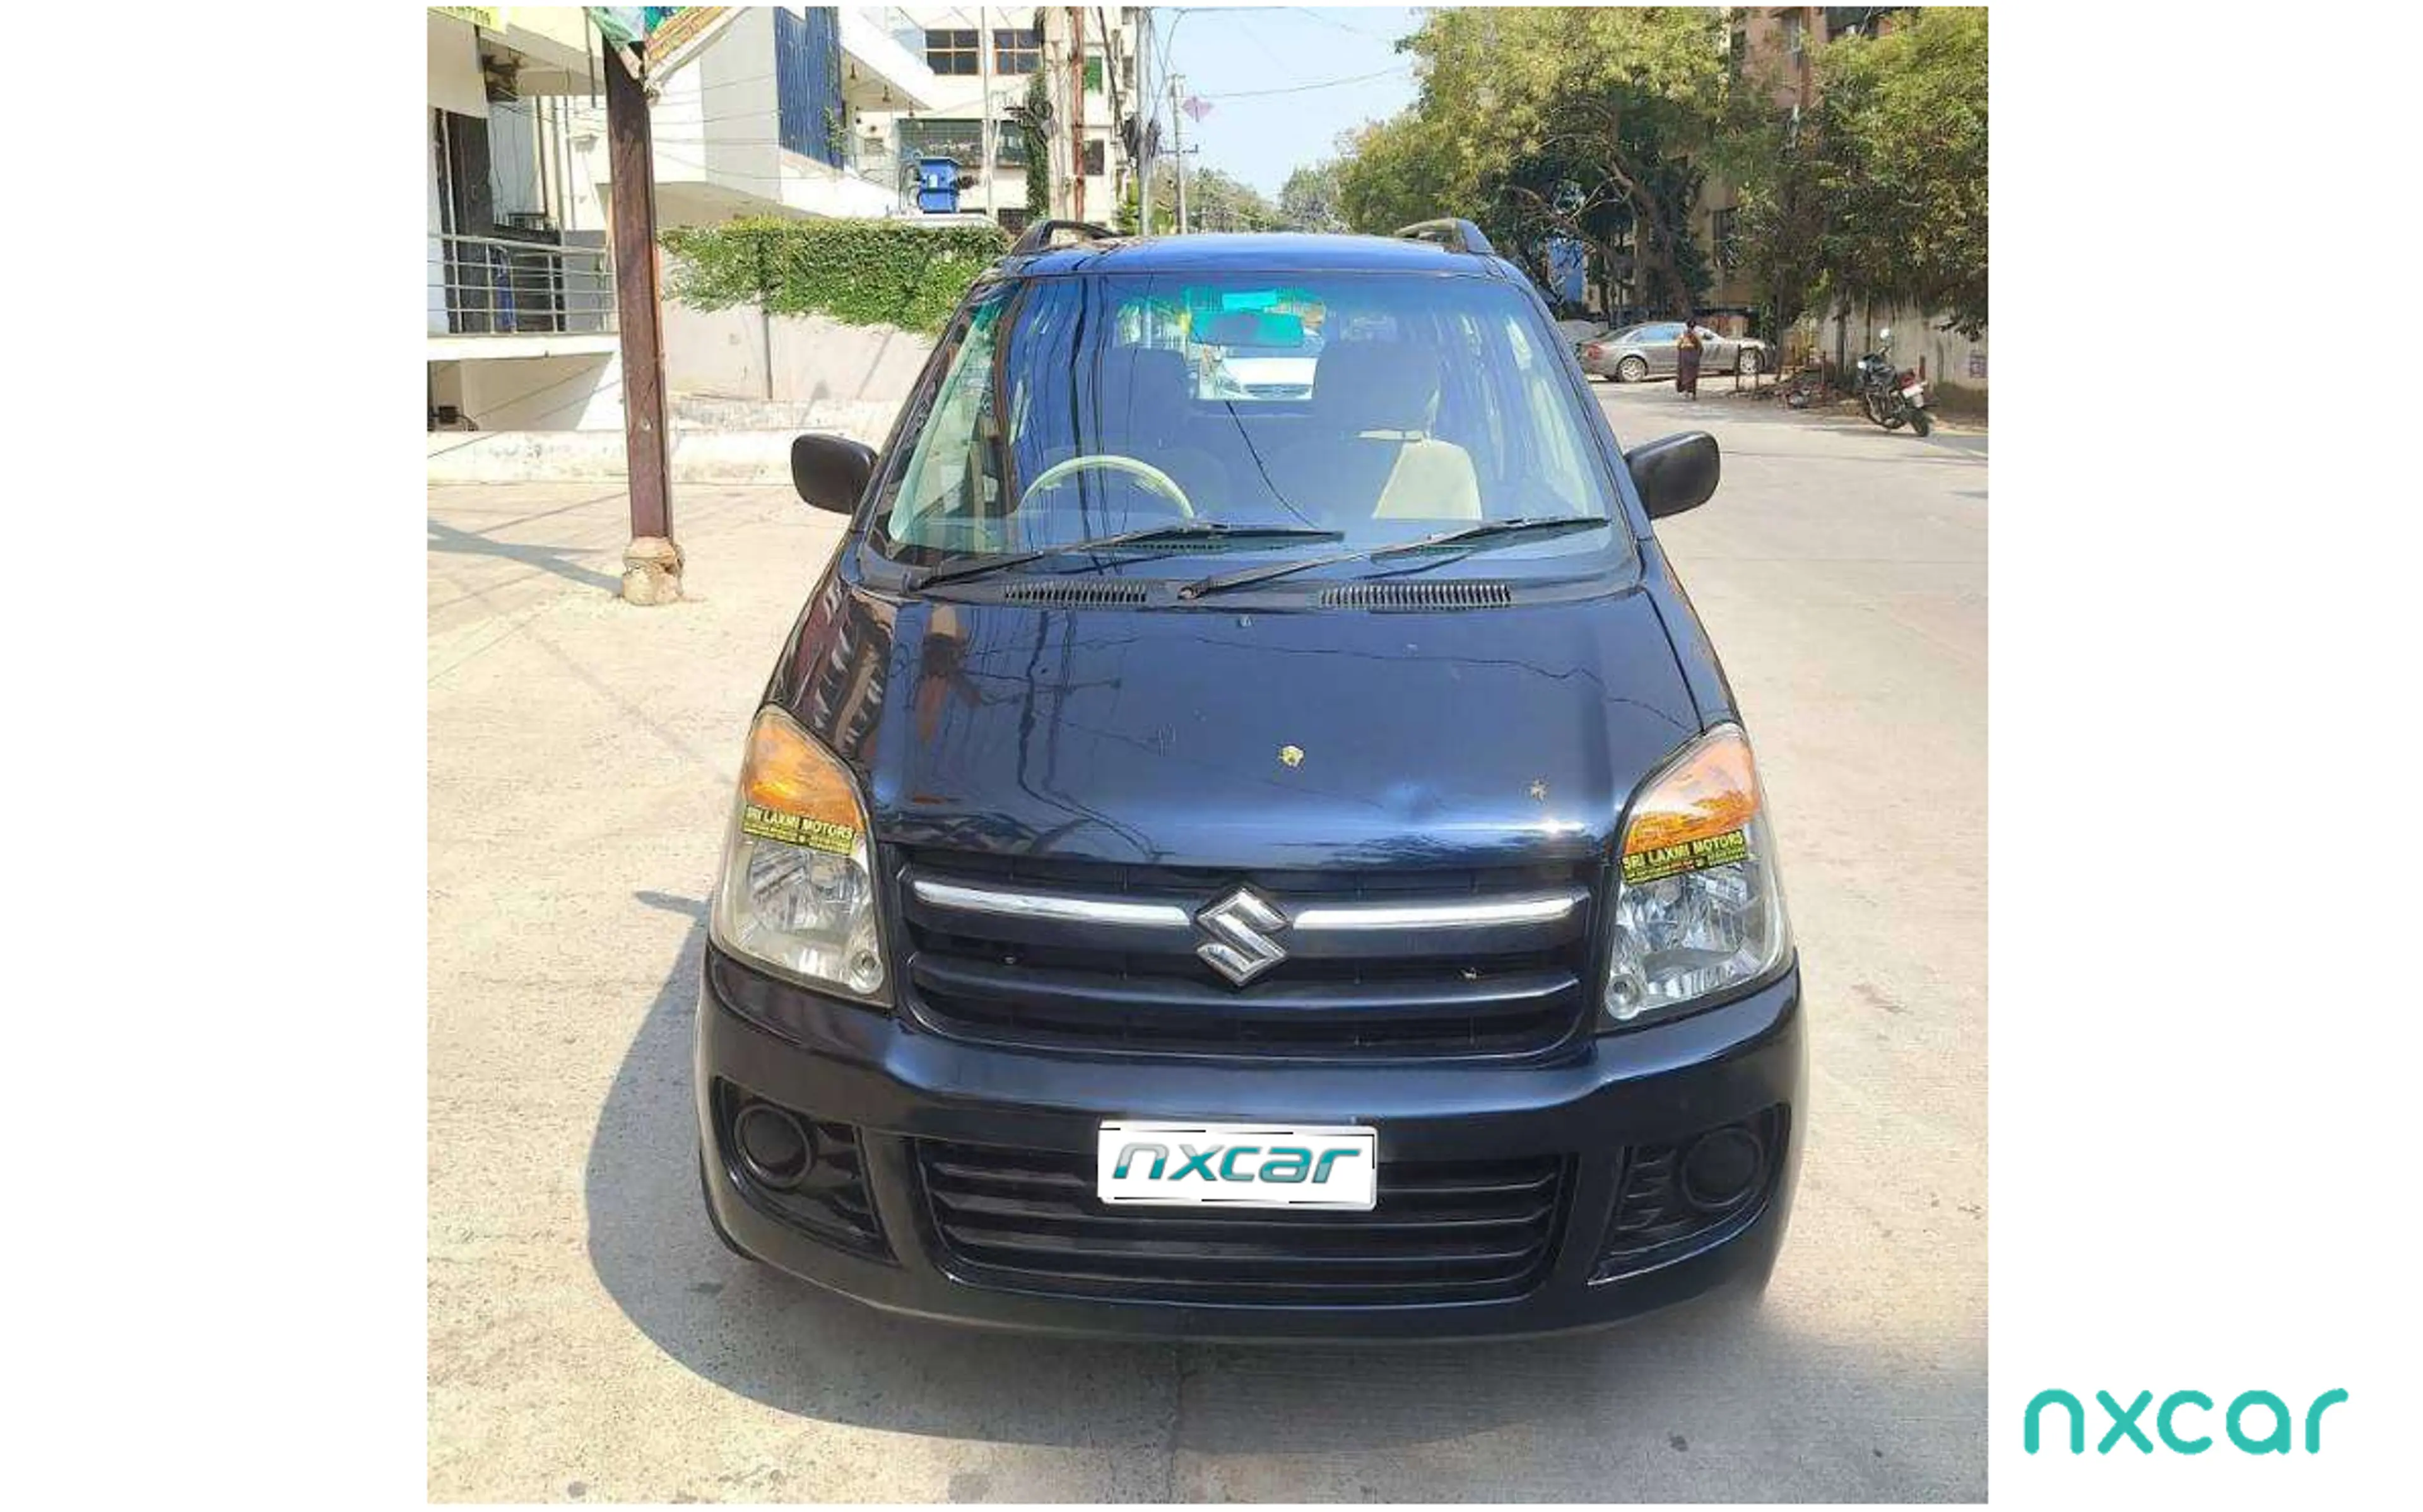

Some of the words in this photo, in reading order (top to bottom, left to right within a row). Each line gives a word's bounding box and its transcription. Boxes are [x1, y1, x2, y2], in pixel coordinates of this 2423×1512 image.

[801, 818, 854, 839] MOTORS
[1622, 854, 1645, 869] SRI
[1648, 845, 1689, 863] LAXMI
[1692, 831, 1744, 854] MOTORS
